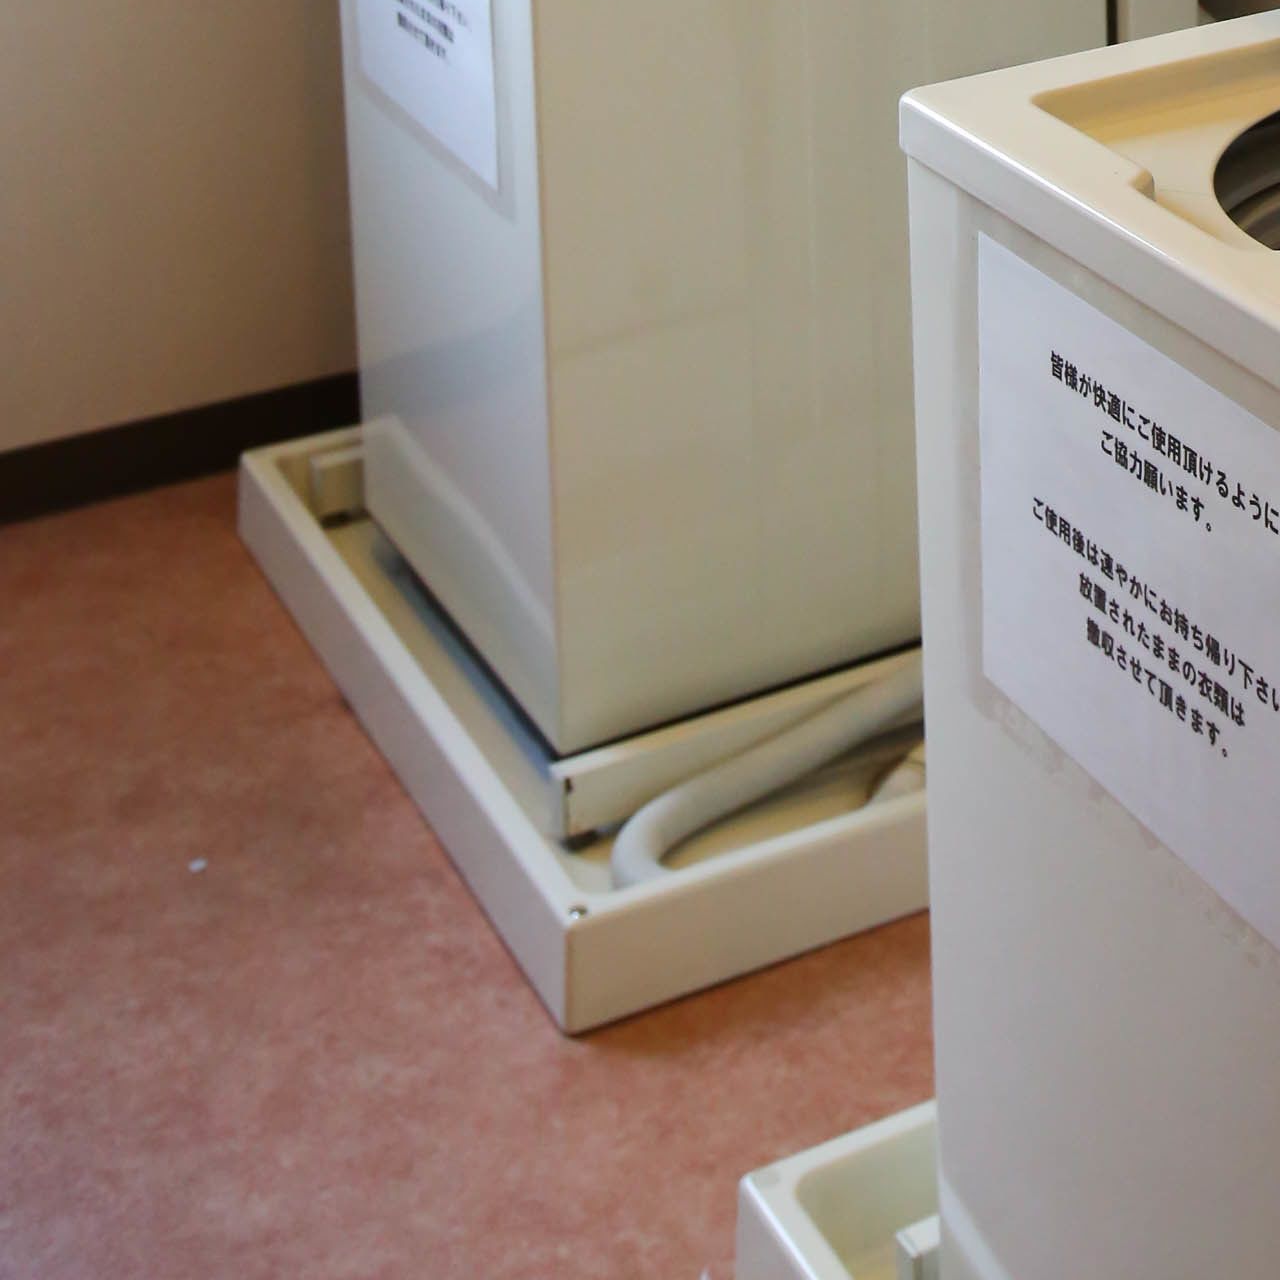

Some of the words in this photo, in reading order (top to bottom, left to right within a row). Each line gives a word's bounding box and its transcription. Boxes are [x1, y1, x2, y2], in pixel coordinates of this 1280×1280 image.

[1051, 350, 1280, 535] 皆様が快適にご使用頂けるように
[1100, 429, 1213, 533] ご協力願います。
[1079, 571, 1246, 727] 放置されたままの衣類は
[1086, 616, 1229, 758] 撤収させて頂きます。
